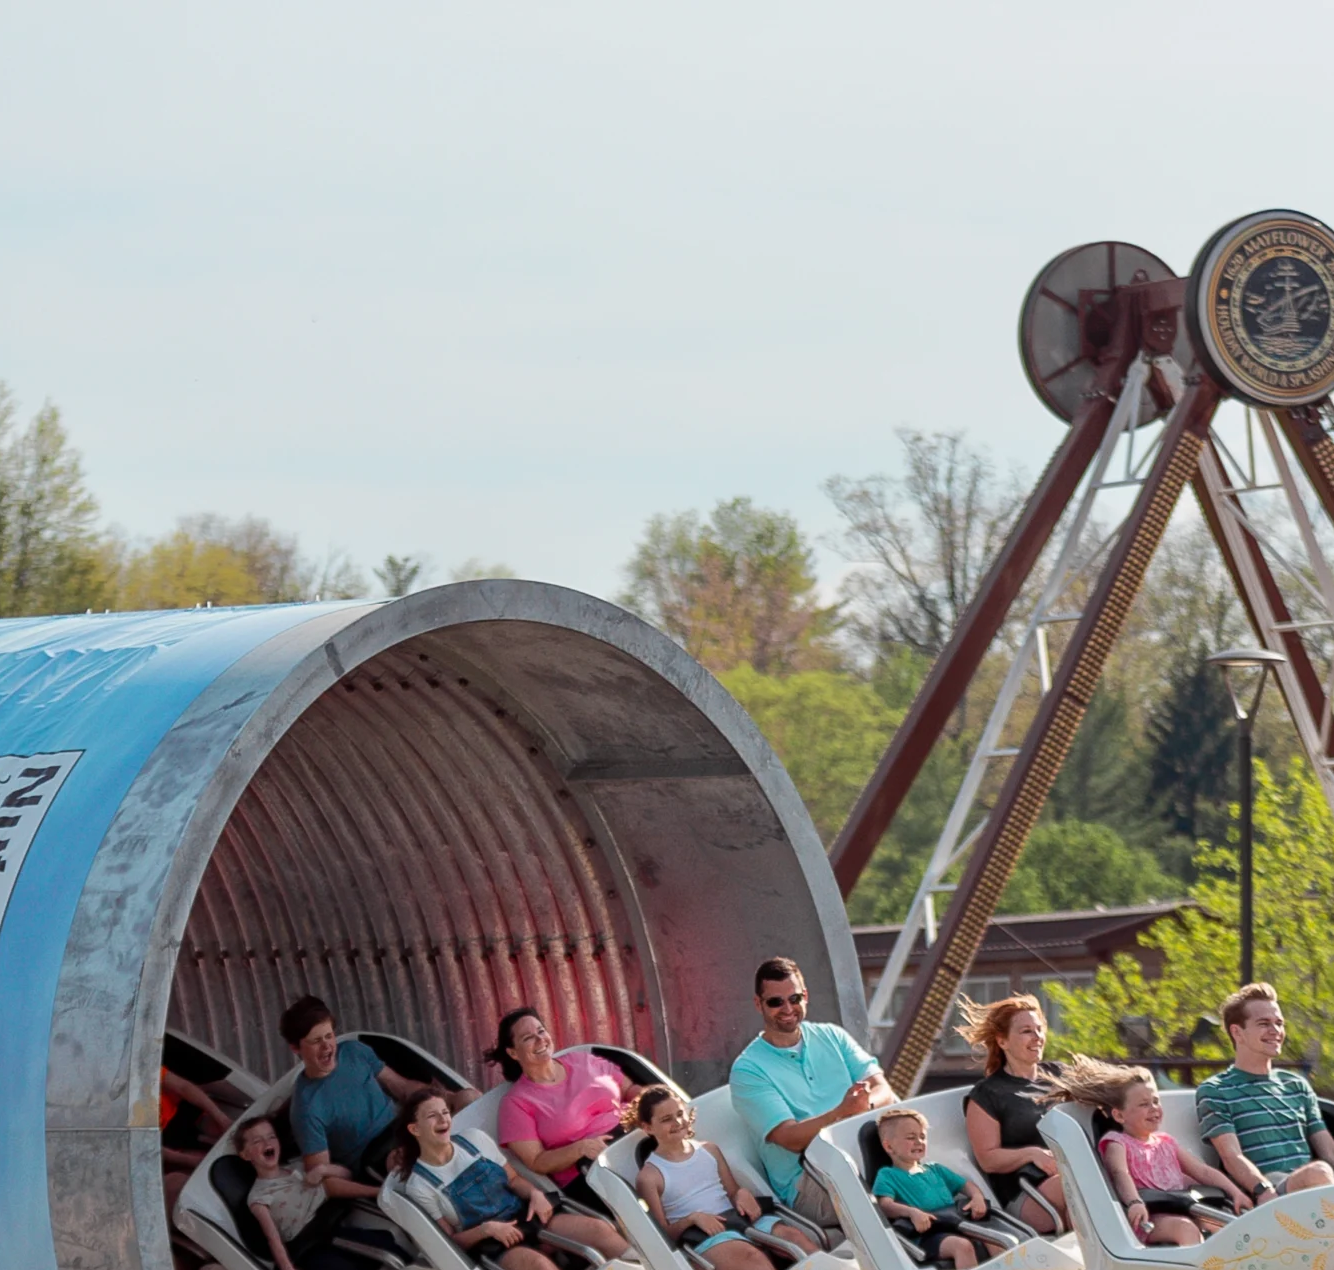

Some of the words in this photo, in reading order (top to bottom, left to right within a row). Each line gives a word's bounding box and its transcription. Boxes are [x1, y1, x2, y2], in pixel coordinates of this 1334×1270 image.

[1243, 230, 1328, 260] MAYFLOWER
[1216, 305, 1240, 362] HOLIDAY
[1239, 354, 1278, 385] WORLD
